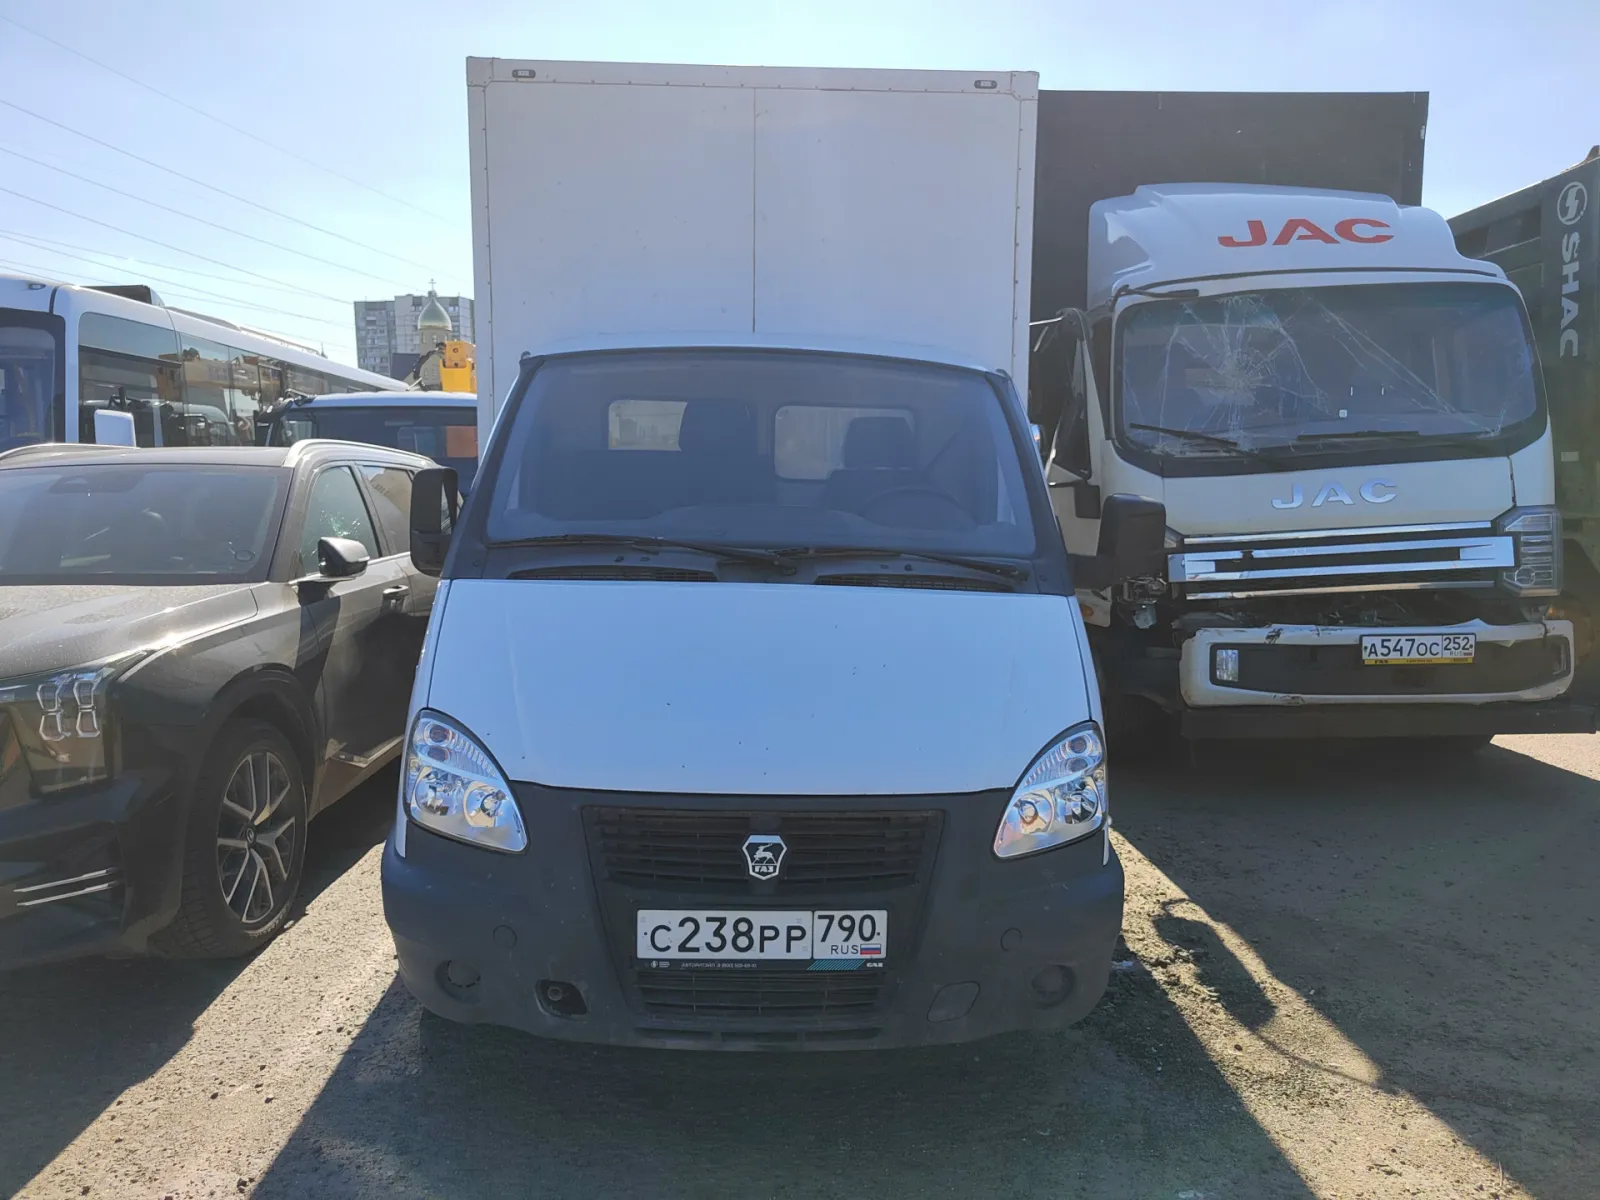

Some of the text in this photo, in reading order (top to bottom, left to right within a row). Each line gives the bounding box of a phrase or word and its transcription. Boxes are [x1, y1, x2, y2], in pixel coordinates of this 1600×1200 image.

[1217, 218, 1395, 248] JAC
[1559, 231, 1580, 358] SHAC
[1271, 479, 1397, 509] JAC
[1367, 636, 1470, 658] А547ОС 252
[754, 865, 774, 873] ГАЗ
[650, 914, 877, 953] С238РР 790
[830, 944, 859, 955] RUS
